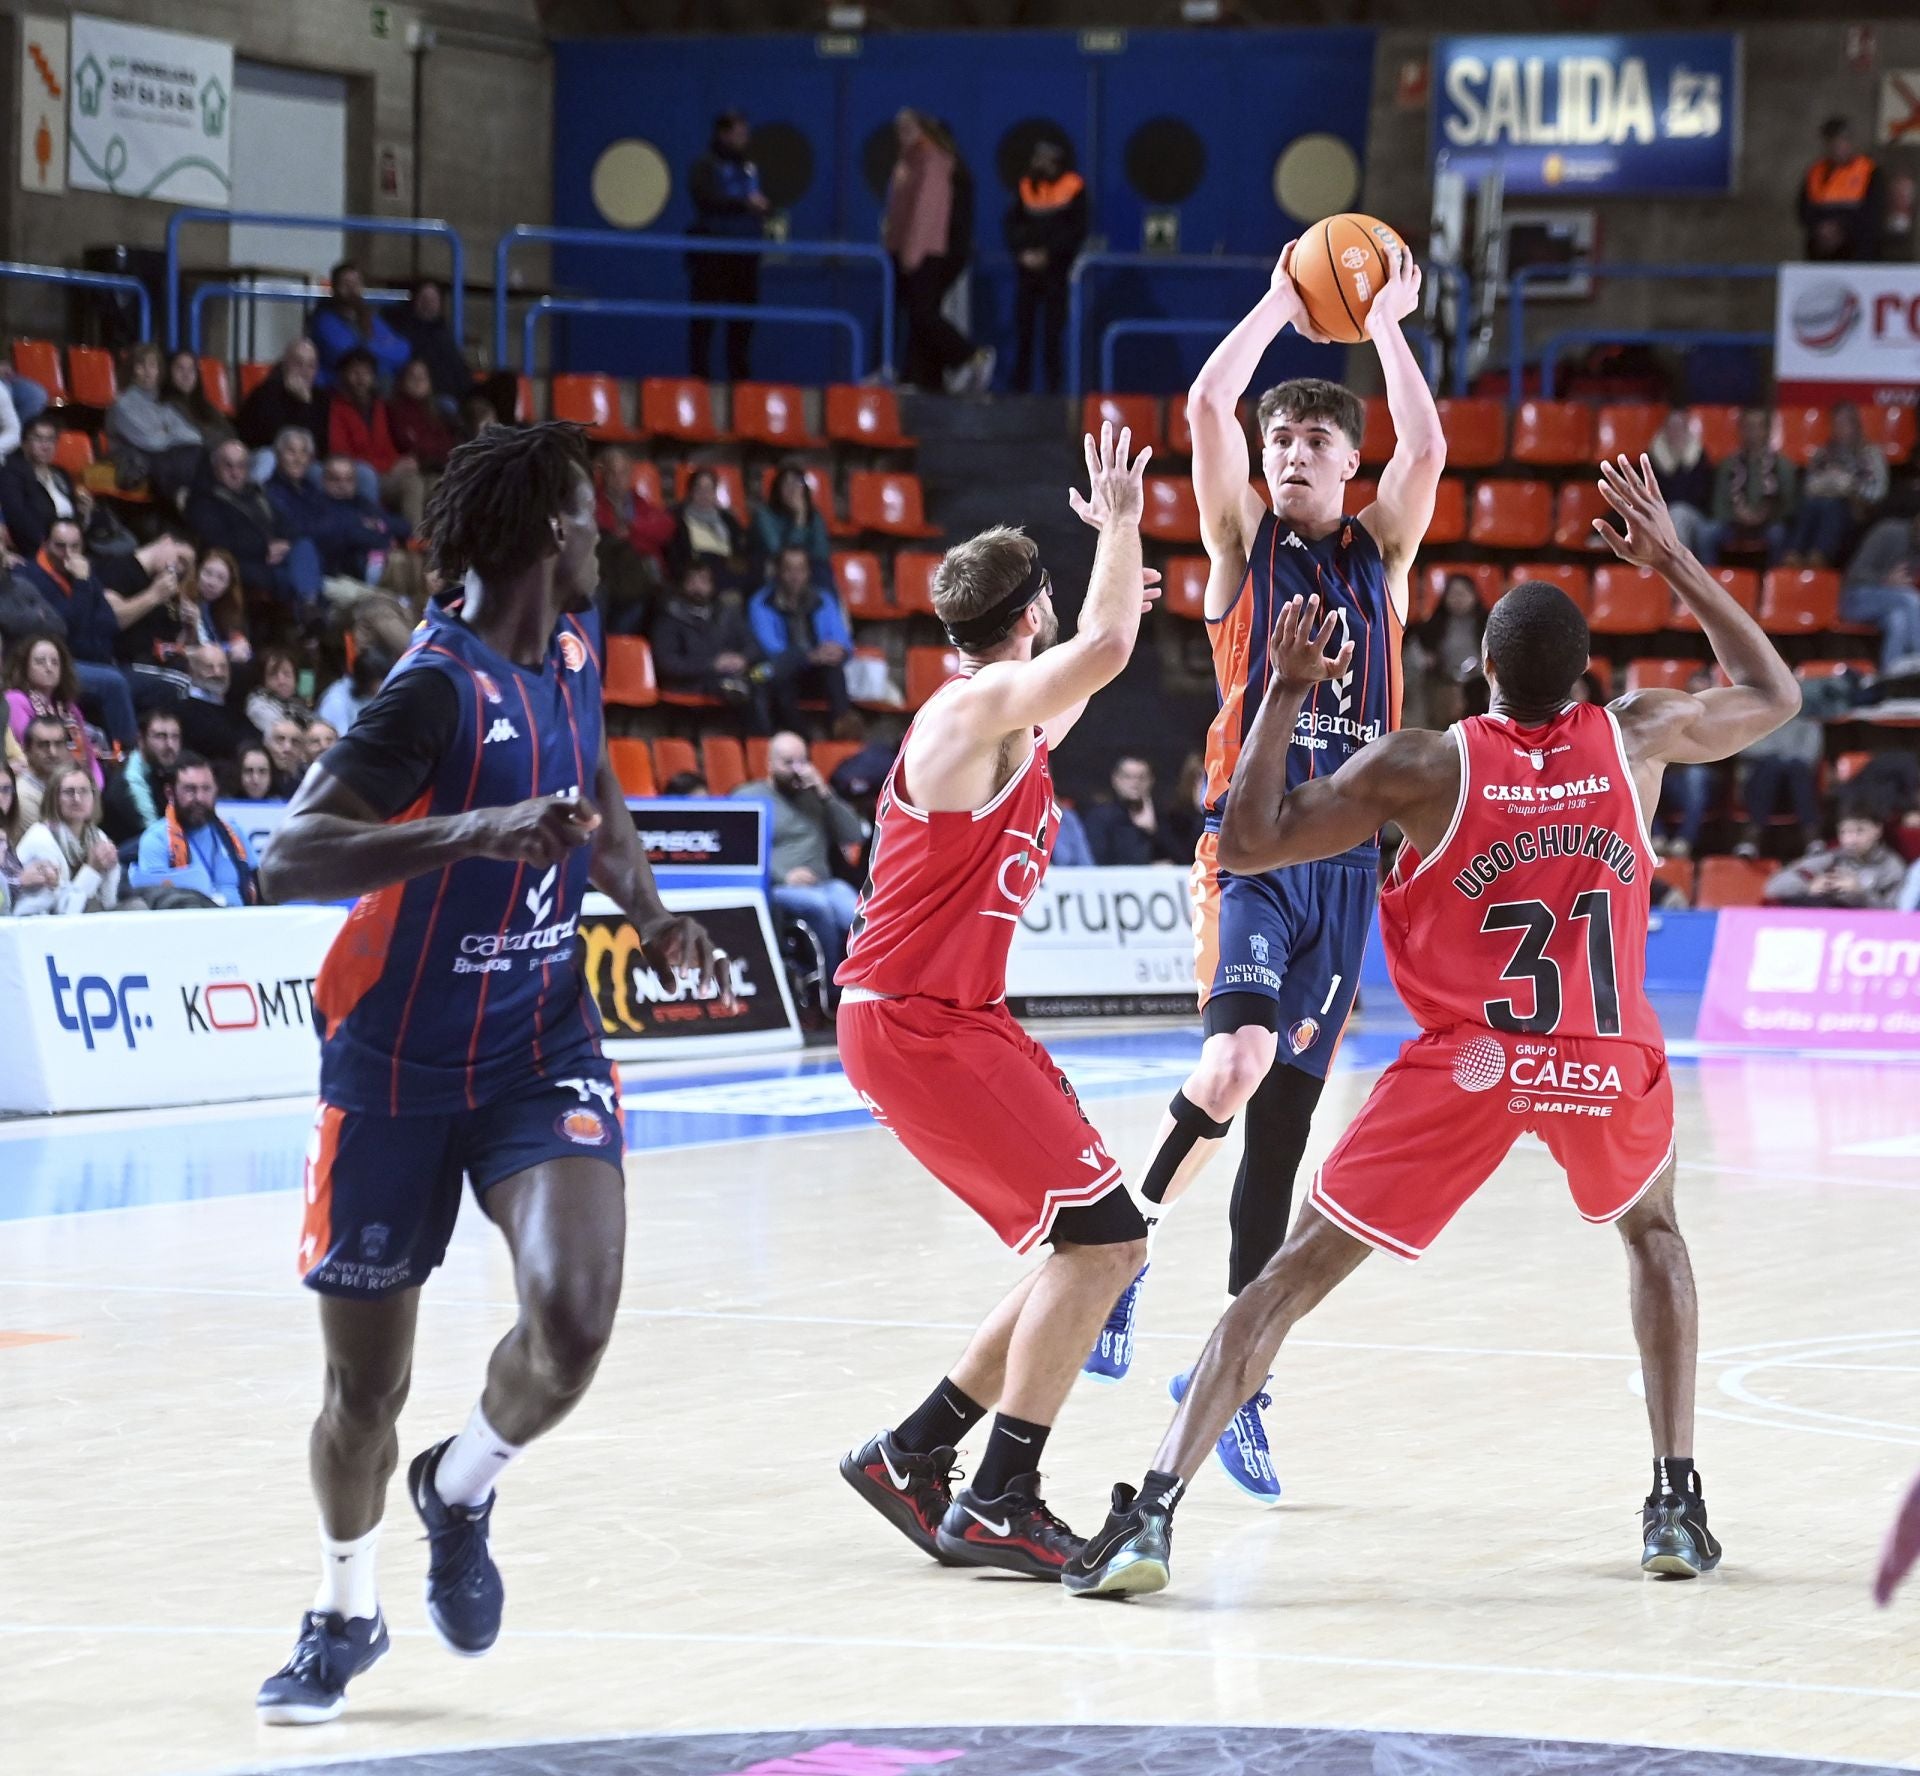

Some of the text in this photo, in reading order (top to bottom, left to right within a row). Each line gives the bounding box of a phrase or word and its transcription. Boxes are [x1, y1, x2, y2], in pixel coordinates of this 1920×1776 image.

[1445, 56, 1656, 145] SALIDA
[1551, 744, 1571, 754] Murcia
[1483, 774, 1611, 801] CASA TOMÁS
[1507, 798, 1587, 816] Grupo desde 1936
[1452, 824, 1636, 899] UGOCHUKWU
[1480, 889, 1622, 1037] 31
[1226, 974, 1241, 984] DE
[1320, 974, 1342, 1015] 1
[1515, 1044, 1557, 1057] GRUPO
[1509, 1058, 1622, 1092] CAESA
[1534, 1101, 1613, 1117] MAPFRE
